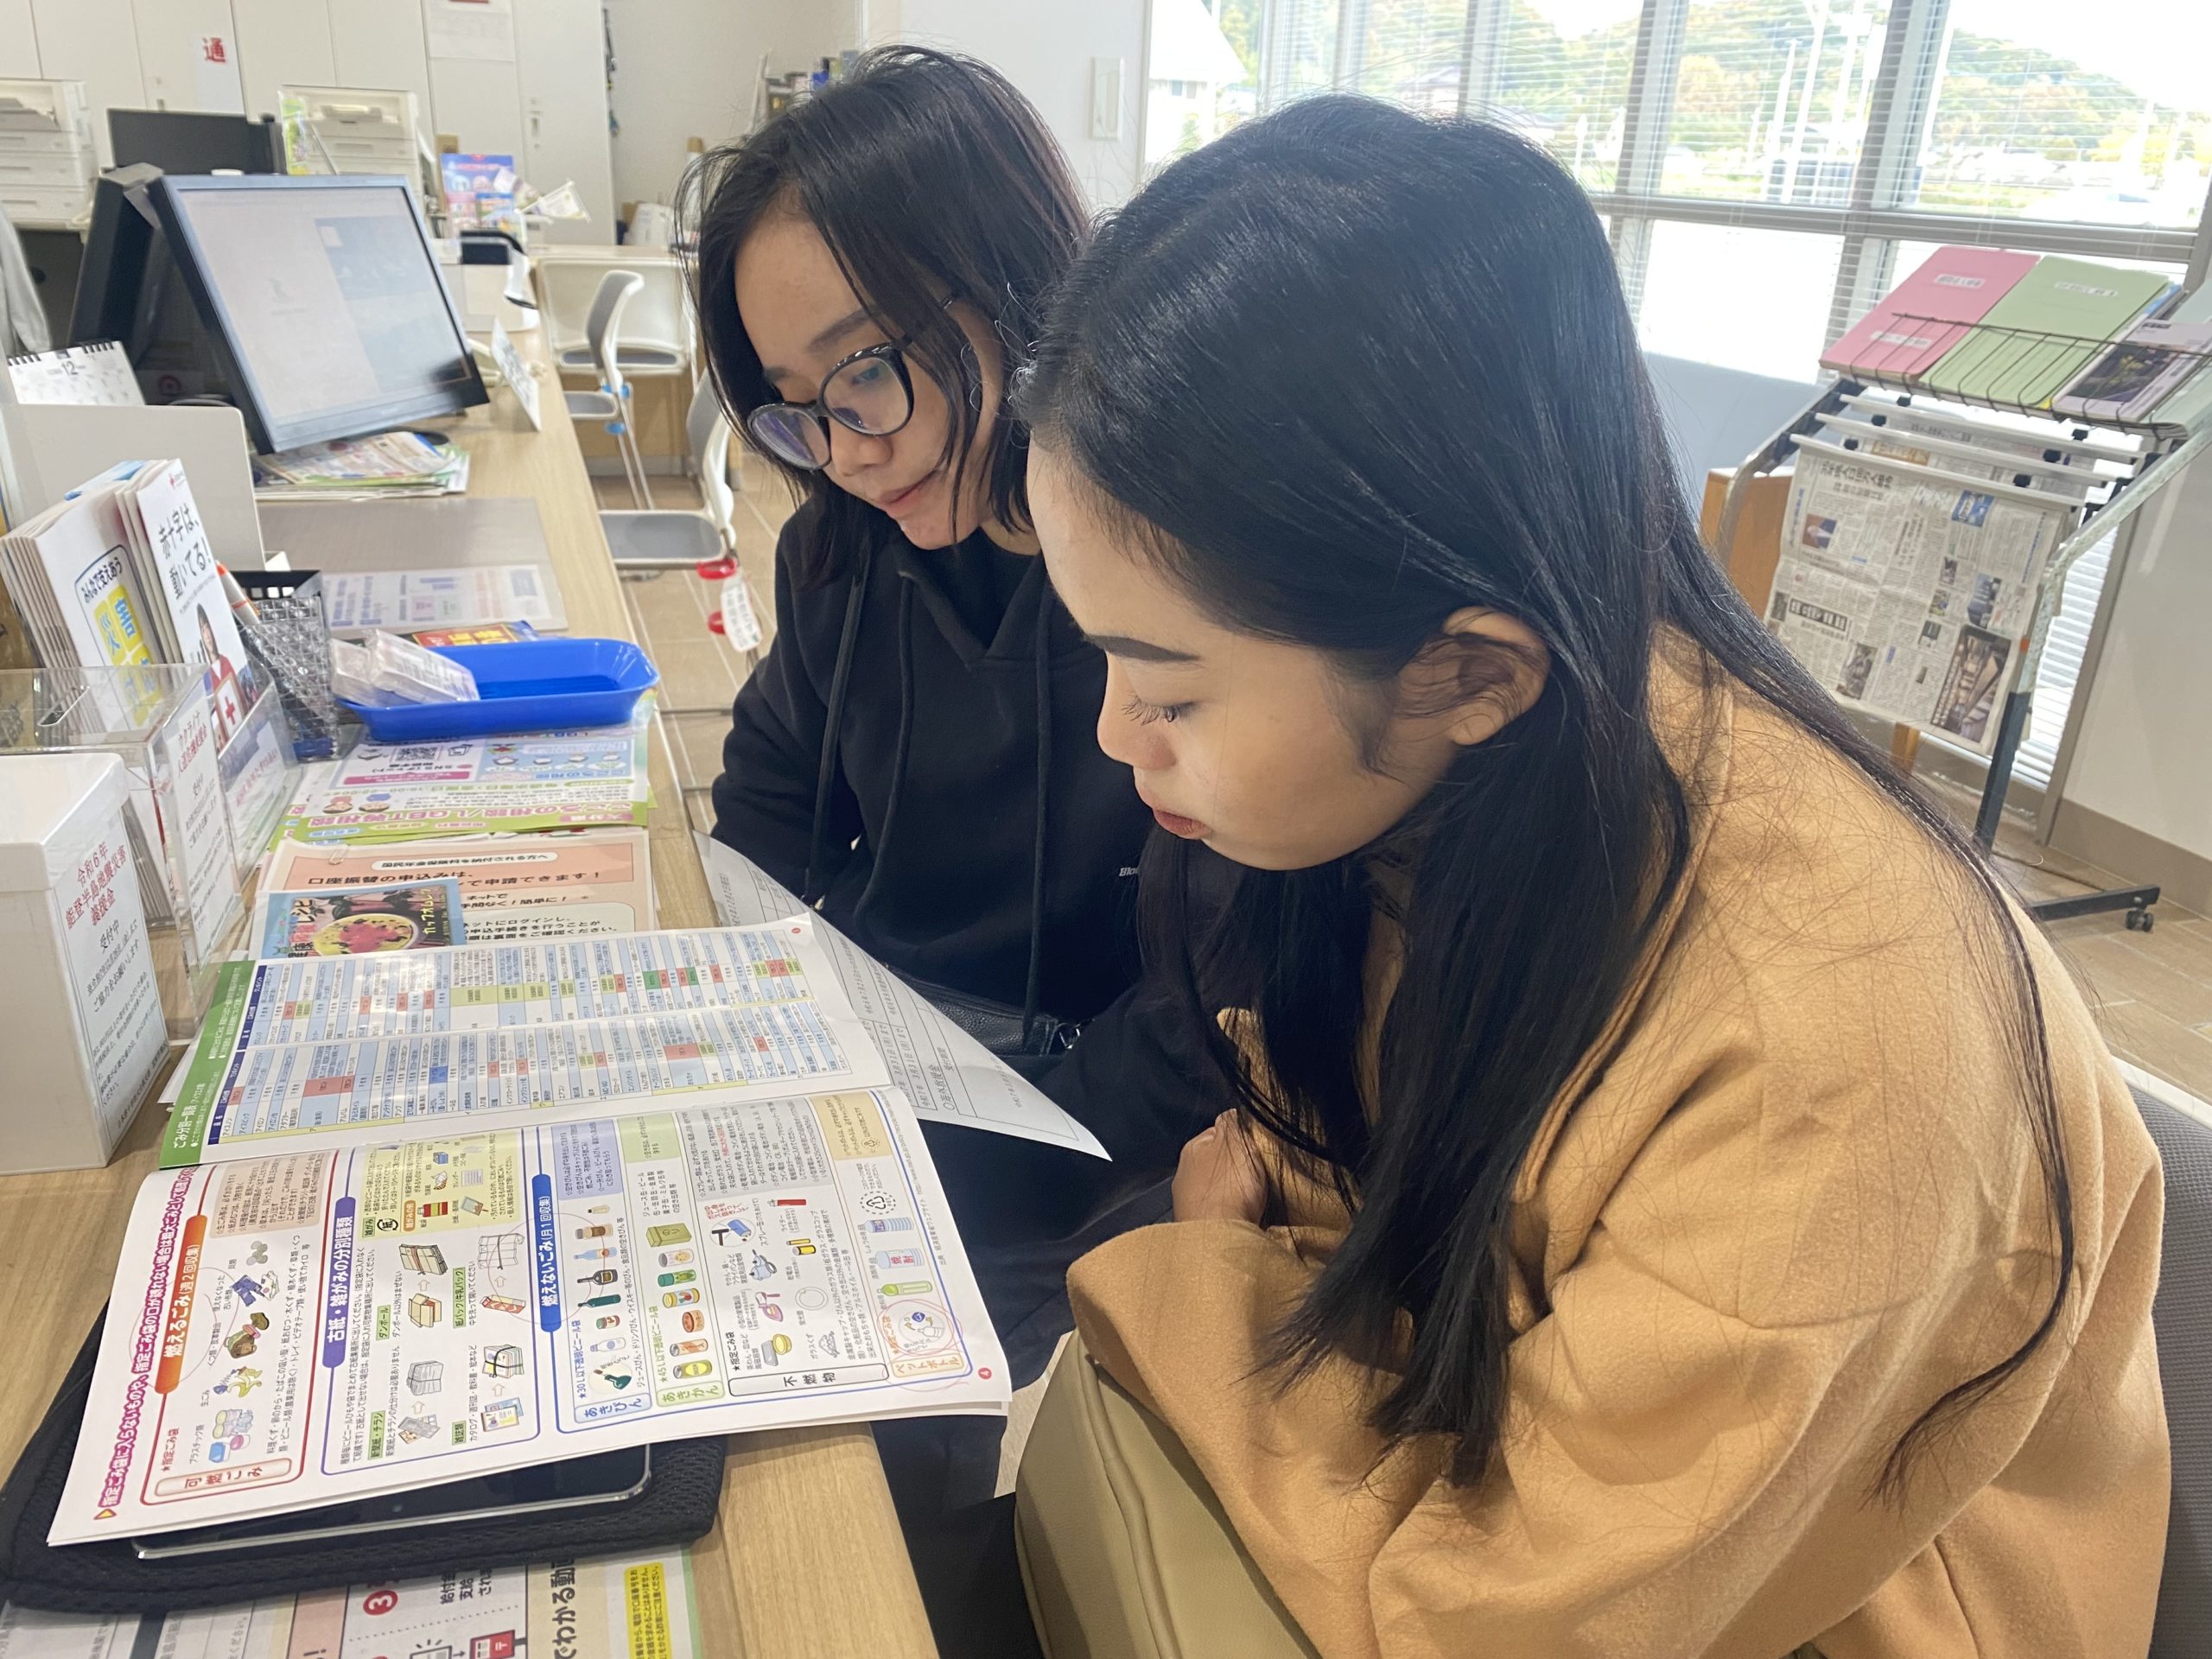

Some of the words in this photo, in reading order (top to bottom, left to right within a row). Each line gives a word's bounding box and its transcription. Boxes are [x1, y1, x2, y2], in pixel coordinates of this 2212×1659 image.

[202, 37, 226, 64] 通
[61, 360, 79, 376] 12
[158, 502, 200, 560] 赤十字は、
[77, 842, 110, 888] 令和6年
[307, 871, 474, 887] 口座振替の申込みは、
[66, 845, 128, 931] 能登半島地震災害
[467, 893, 508, 901] ネットで
[91, 888, 118, 927] 義援金
[100, 919, 120, 955] 受付中
[173, 1105, 196, 1148] ごみ分別一覧表
[639, 1173, 650, 1217] ジュース缶・ビール
[365, 1217, 374, 1236] 雑がみ
[381, 1221, 393, 1230] 紙
[728, 1254, 740, 1285] フライパンなど
[891, 1255, 913, 1265] 焼酎
[212, 1274, 226, 1313] 使えなくなった
[327, 1216, 353, 1343] 古紙・雑がみの分別種類
[467, 1261, 477, 1326] 中を洗って開いてください
[392, 1270, 403, 1338] ダンボール以外はまぜない
[454, 1267, 465, 1327] 紙パック(牛乳パック)
[378, 1307, 389, 1338] ダンボール
[726, 1331, 740, 1365] 指定ごみ袋
[806, 1333, 817, 1360] ガラスくず
[783, 1371, 836, 1388] 不燃物
[896, 1357, 960, 1374] ペットボトル
[200, 1389, 210, 1408] 生ごみ
[467, 1344, 478, 1441] カタログ・週刊誌・教科書・絵本など
[584, 1398, 642, 1417] あきびん
[663, 1385, 719, 1402] あきかん
[189, 1424, 204, 1464] プラスチック類
[371, 1412, 383, 1459] 新聞紙・チラシ
[454, 1422, 464, 1444] 雑誌類
[184, 1466, 263, 1489] 可燃ごみ
[367, 1594, 393, 1611] 3
[460, 1578, 474, 1600] 支給
